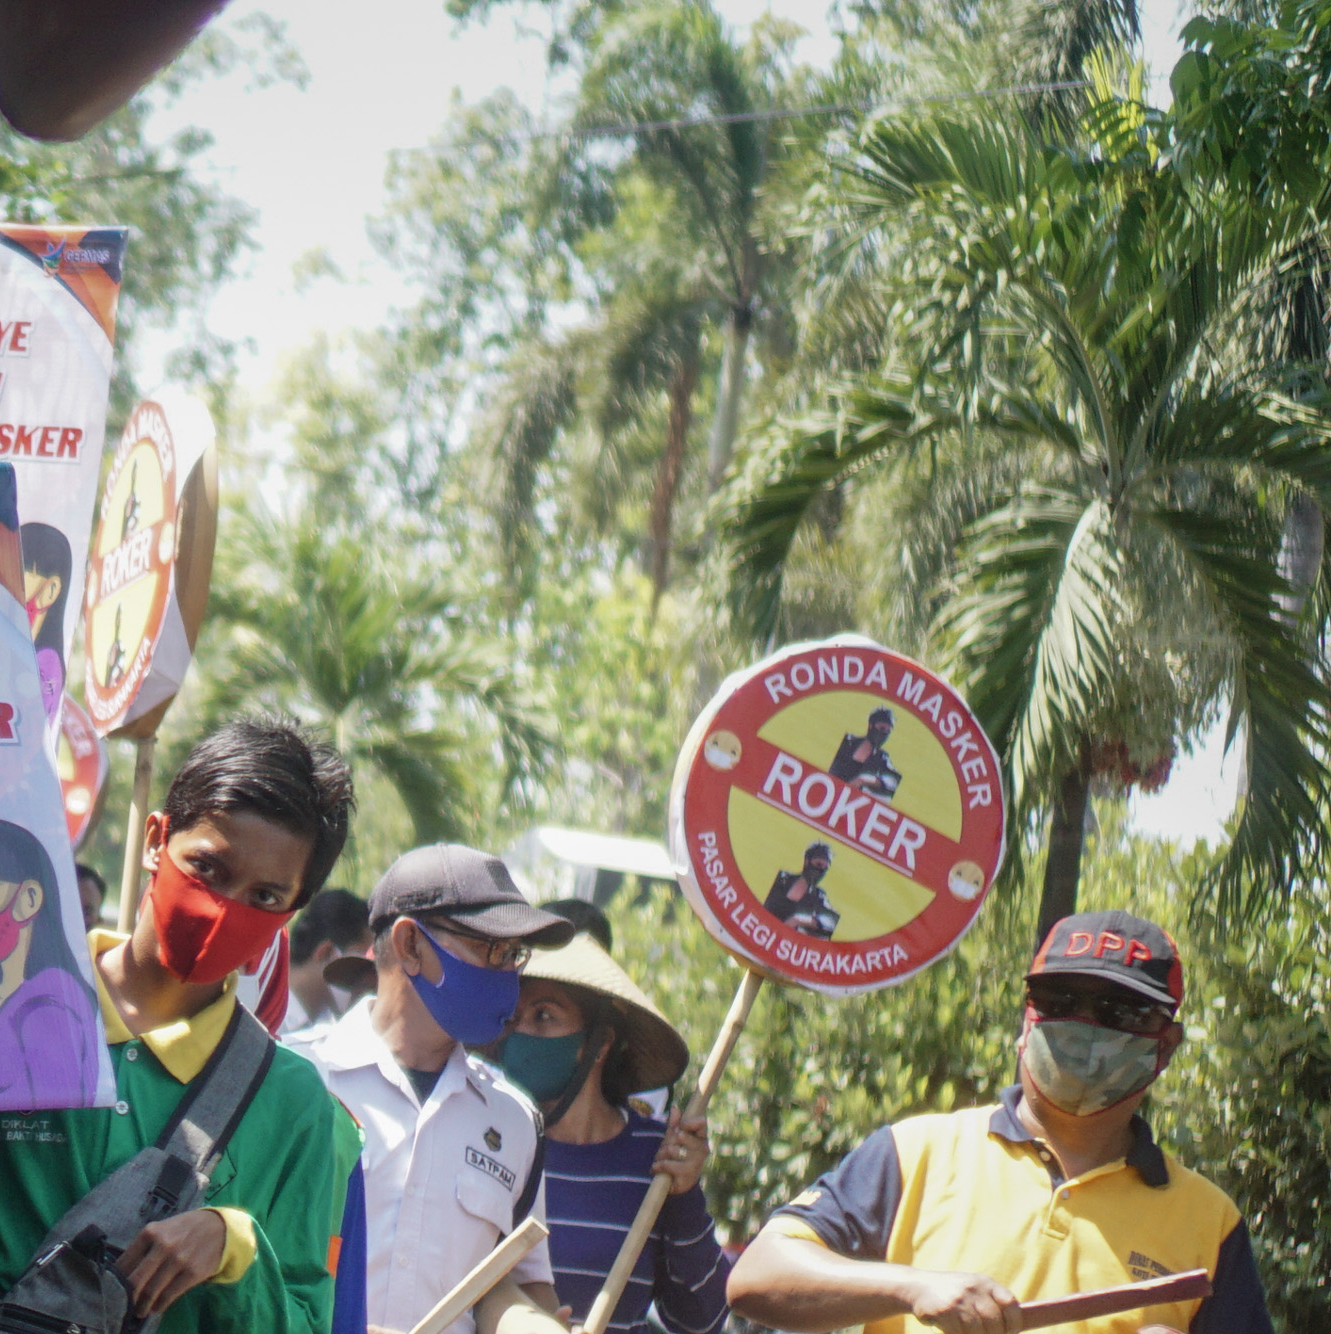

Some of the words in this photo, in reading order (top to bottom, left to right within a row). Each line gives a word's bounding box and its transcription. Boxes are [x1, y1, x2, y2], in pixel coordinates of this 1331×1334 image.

[764, 655, 888, 704] RONDA
[895, 671, 993, 811] MASKER
[761, 751, 928, 872] ROKER
[697, 830, 738, 910] PASAR
[730, 902, 777, 952] LEGI
[775, 942, 910, 976] SURAKARTA
[1063, 930, 1153, 967] DPP
[1, 1120, 49, 1129] DIKLAT
[470, 1152, 512, 1185] SATPAM
